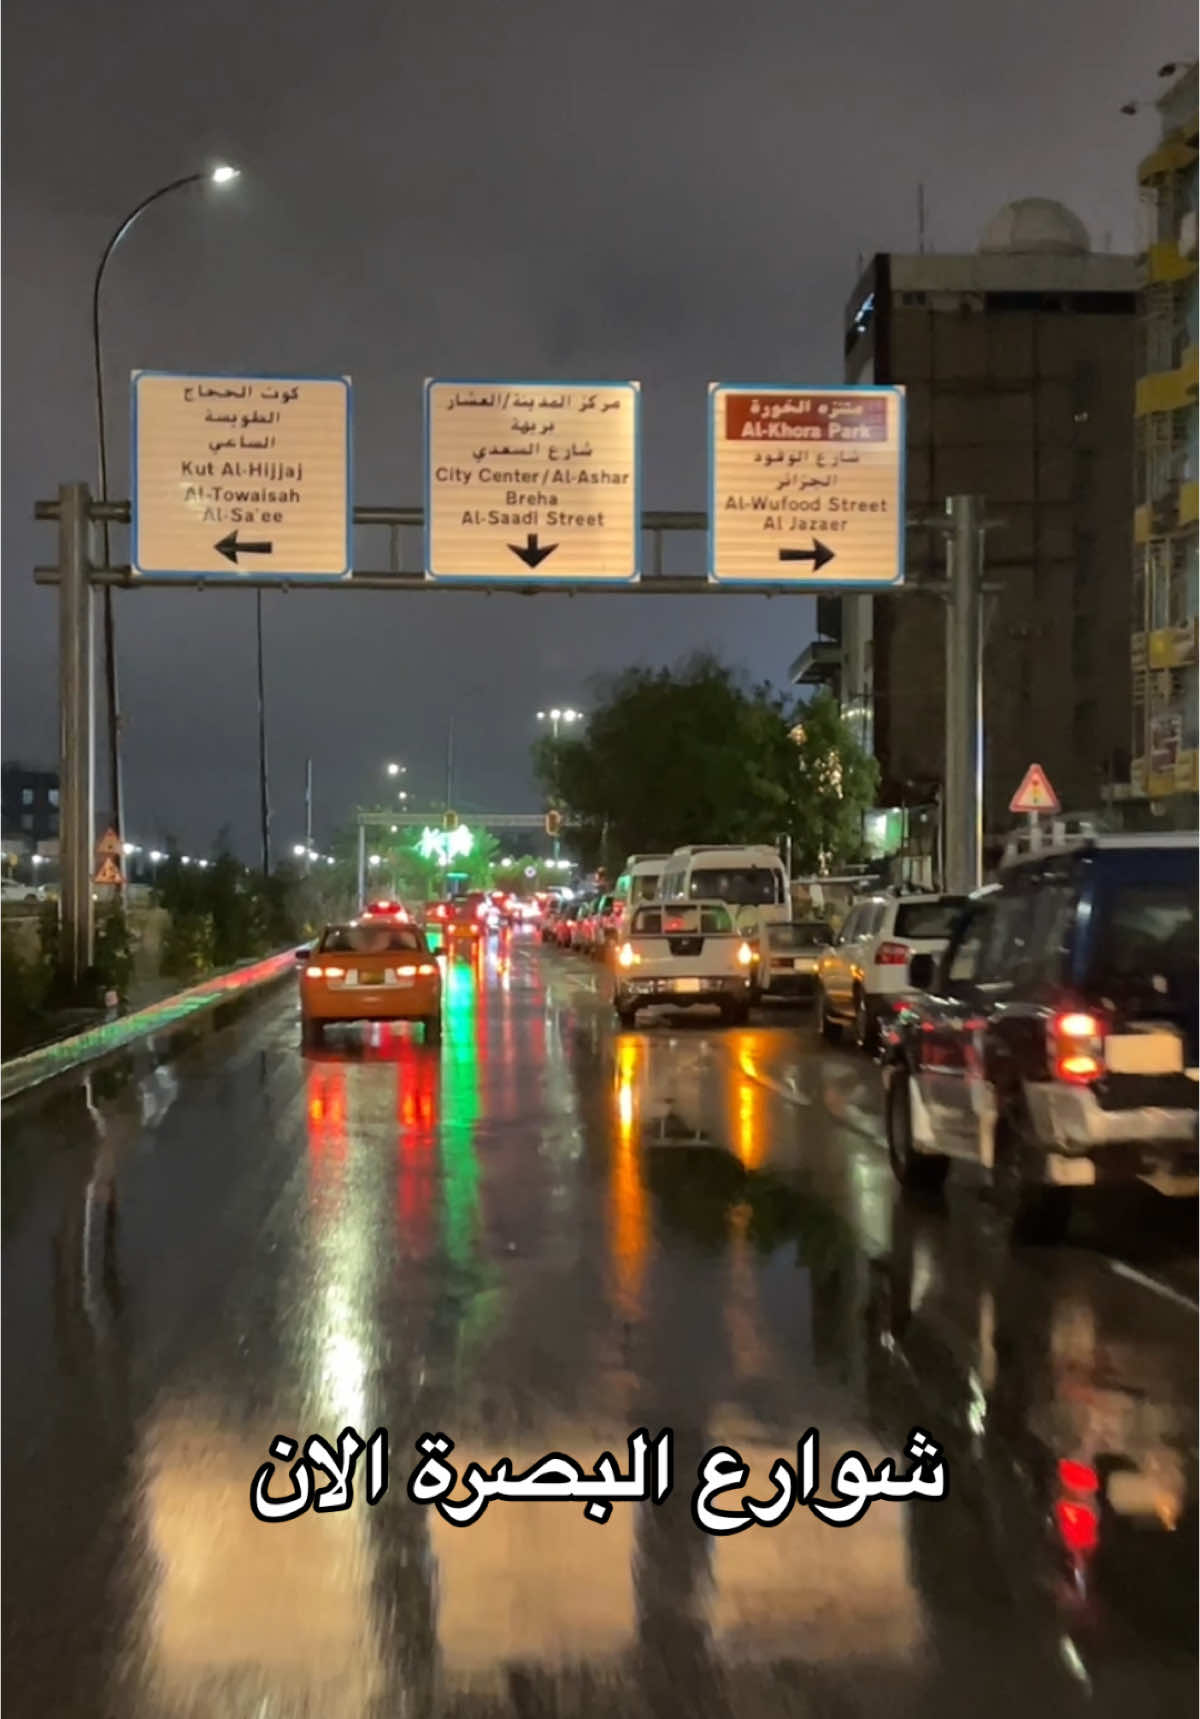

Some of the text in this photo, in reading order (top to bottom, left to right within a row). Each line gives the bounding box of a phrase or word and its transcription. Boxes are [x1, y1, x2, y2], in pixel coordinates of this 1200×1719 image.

[261, 386, 299, 404] كوت
[579, 394, 621, 413] مركز
[741, 421, 871, 439] Al-Khora Park
[472, 442, 593, 463] شارع السعدي
[816, 450, 860, 467] شارع
[181, 461, 303, 480] Kut Al-Hijjaj
[435, 467, 472, 485] City
[184, 486, 300, 503] Al-Towaisah
[506, 491, 559, 506] Breha
[725, 496, 887, 512] Al-Wufood Street
[462, 510, 605, 527] Al-Saadi Street
[789, 516, 848, 531] Jazaer
